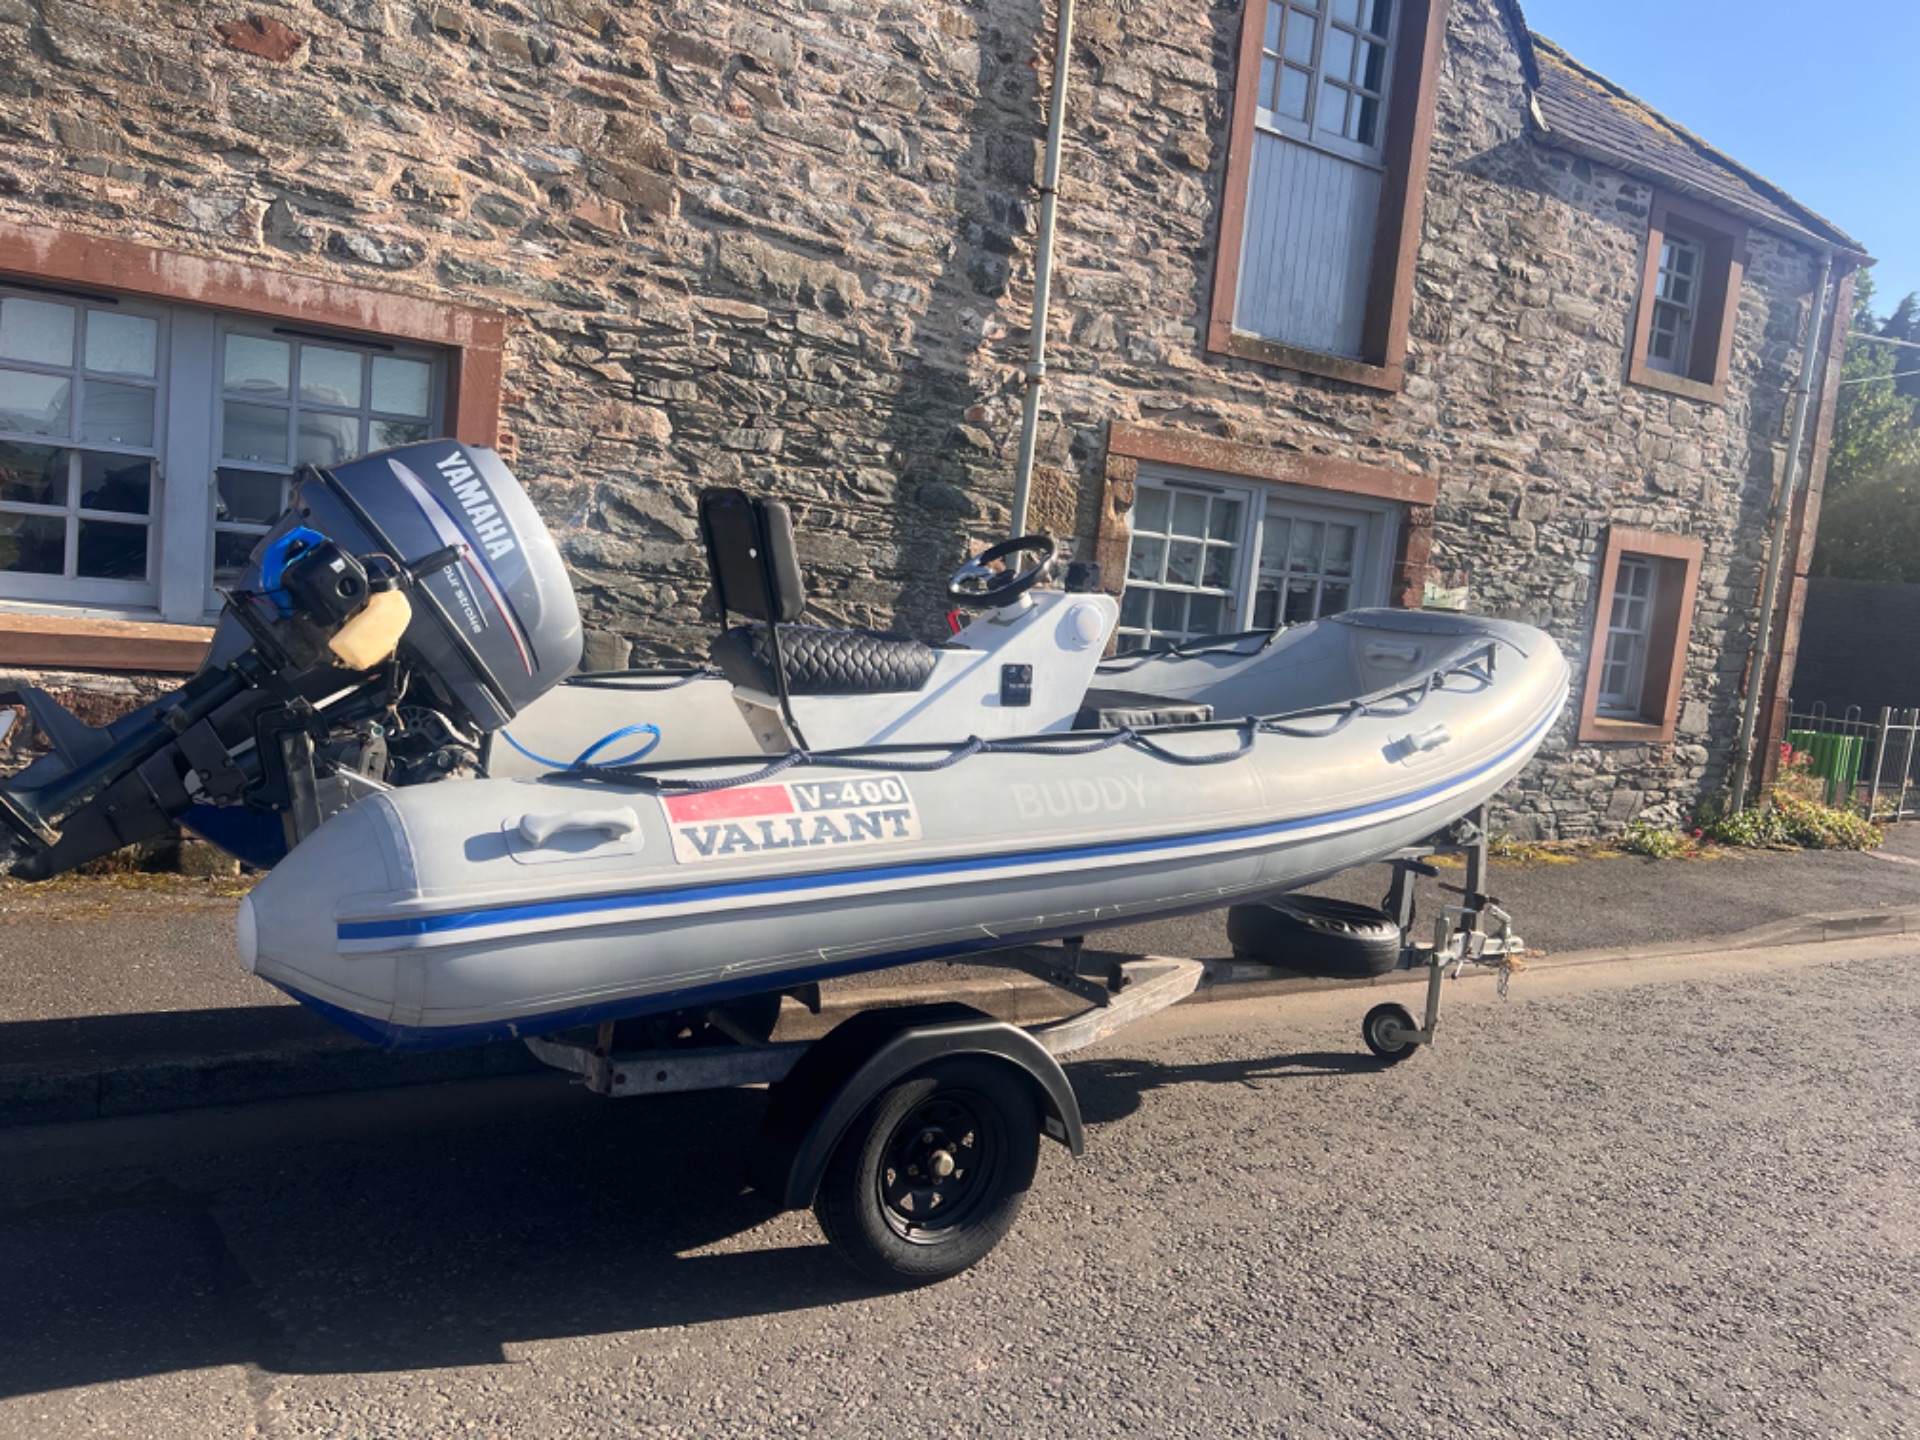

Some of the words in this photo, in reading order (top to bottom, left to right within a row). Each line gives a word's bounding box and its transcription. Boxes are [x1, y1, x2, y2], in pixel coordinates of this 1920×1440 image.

[436, 451, 515, 560] YAMAHA
[443, 565, 460, 587] our
[796, 779, 902, 808] V-400
[1010, 772, 1146, 819] BUDDY
[680, 809, 911, 856] VALIANT
